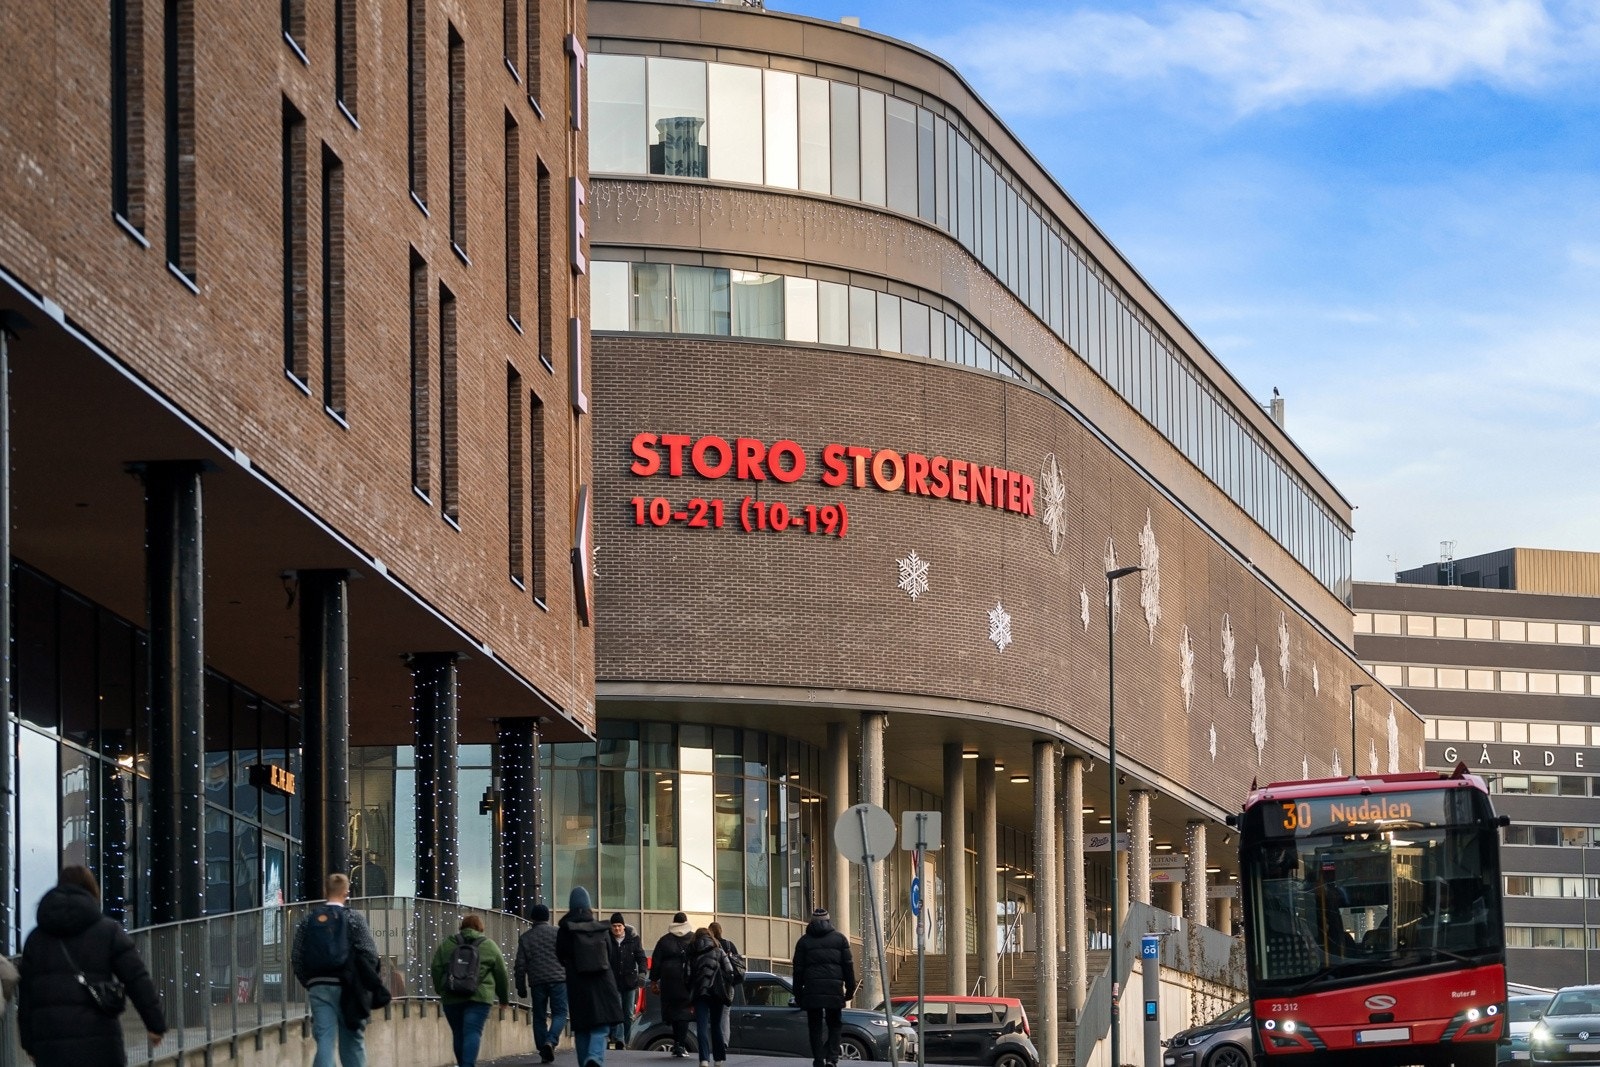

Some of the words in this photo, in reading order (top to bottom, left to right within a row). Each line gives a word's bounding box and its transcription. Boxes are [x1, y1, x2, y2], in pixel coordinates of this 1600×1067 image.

[630, 432, 807, 483] STORO
[821, 443, 1035, 516] STORSENTER
[631, 496, 725, 528] 10-21
[739, 496, 849, 538] (10-19)
[1444, 743, 1584, 768] GÅRDE
[1282, 802, 1312, 830] 30
[1330, 798, 1412, 827] Nydalen
[1272, 1004, 1282, 1012] 23
[1284, 1003, 1298, 1011] 312
